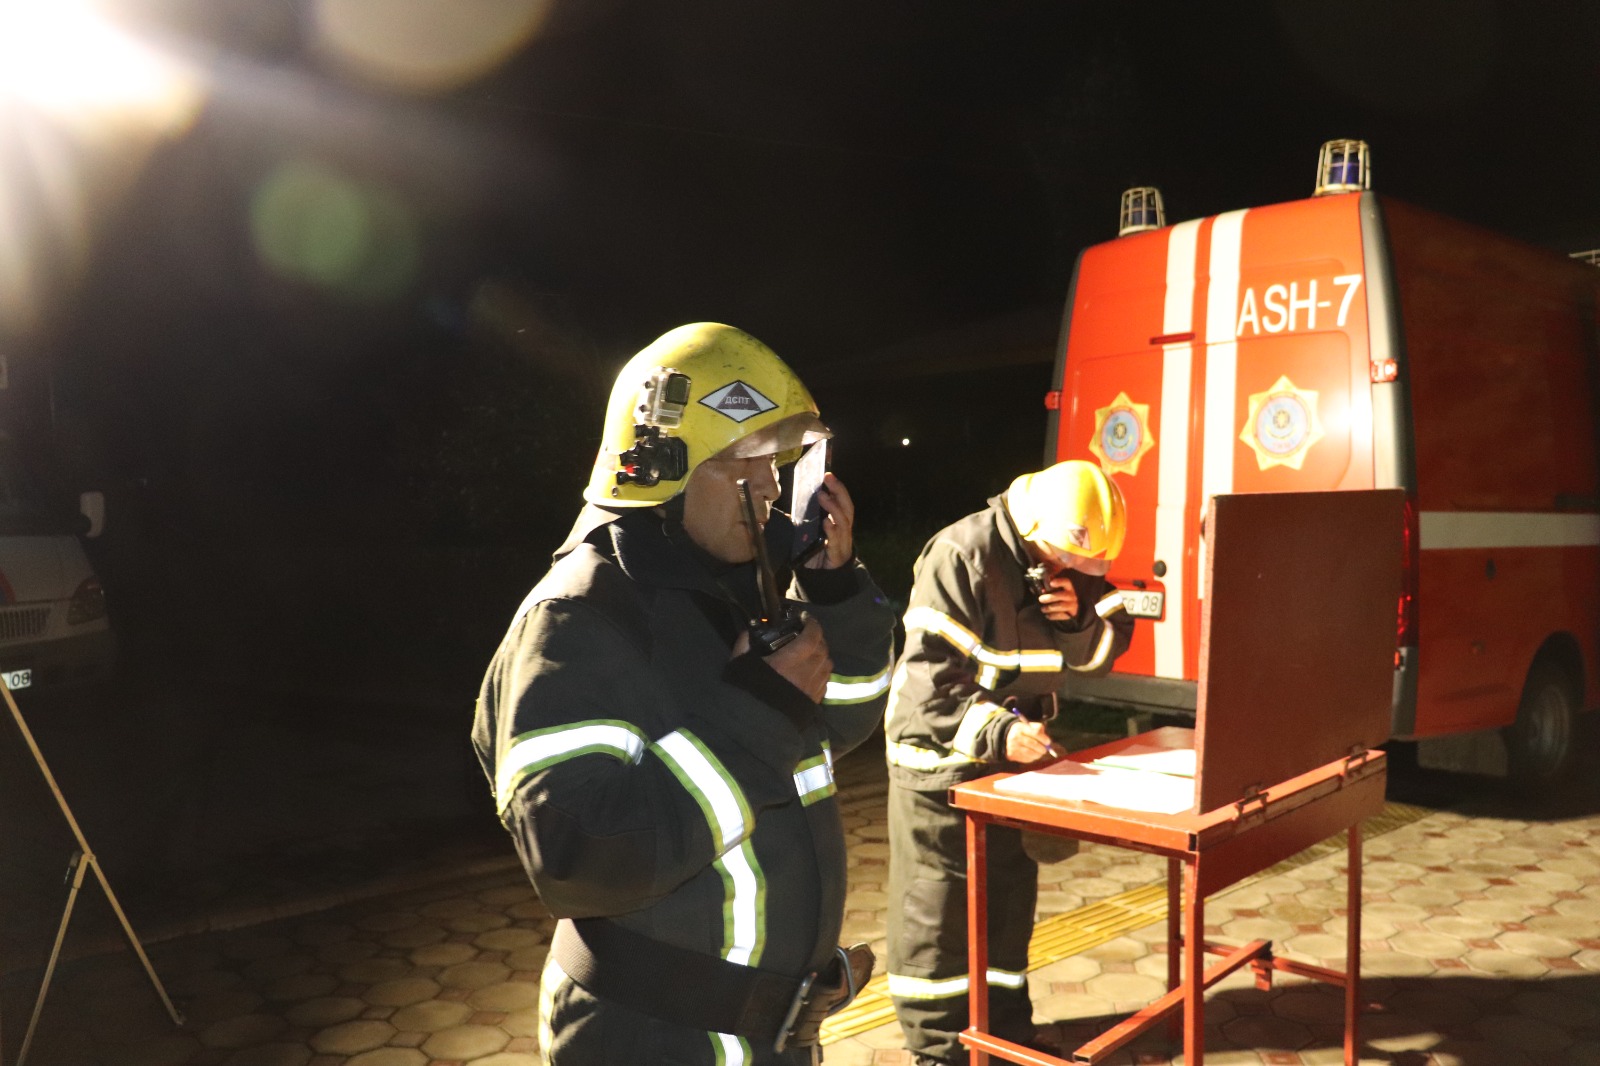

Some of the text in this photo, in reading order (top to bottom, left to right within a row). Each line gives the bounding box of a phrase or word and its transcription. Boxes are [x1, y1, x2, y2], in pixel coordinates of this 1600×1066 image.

[1236, 274, 1362, 336] ASH-7
[724, 396, 750, 405] ДСПТ
[1141, 595, 1159, 612] 08
[12, 672, 30, 687] 08
